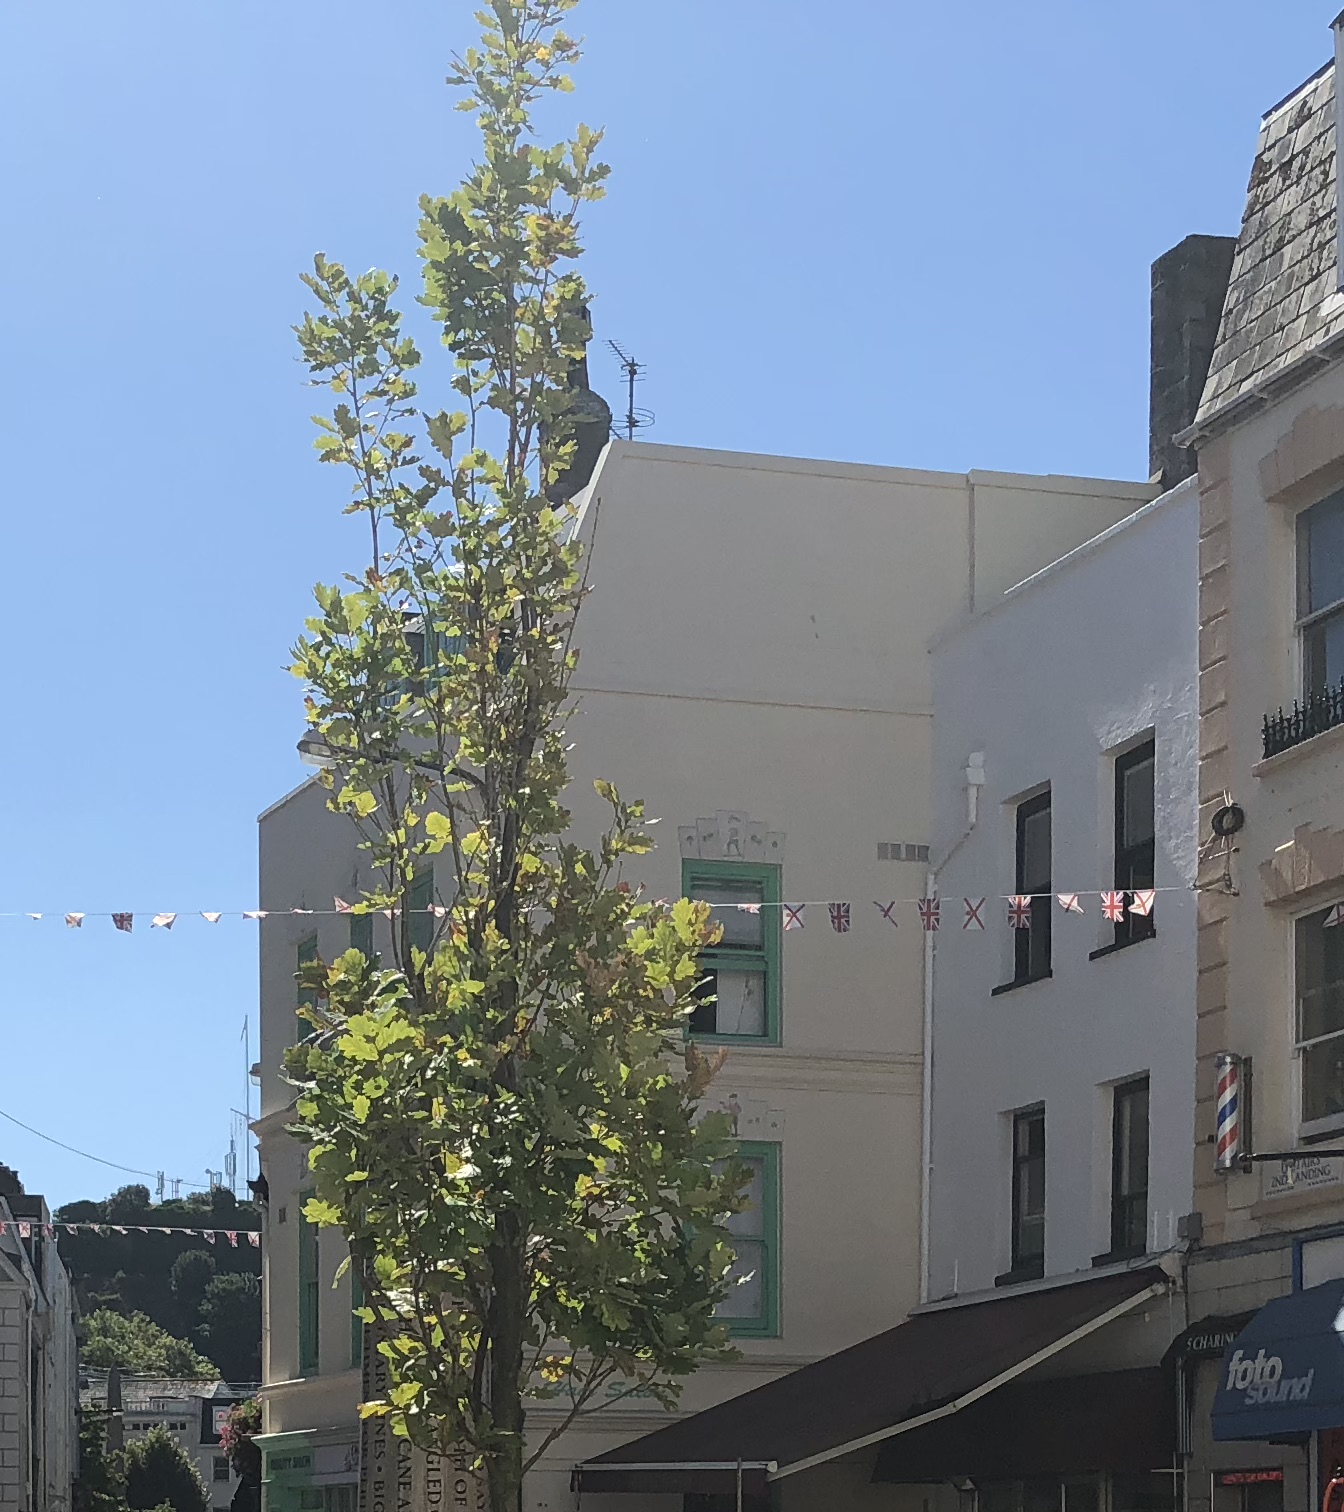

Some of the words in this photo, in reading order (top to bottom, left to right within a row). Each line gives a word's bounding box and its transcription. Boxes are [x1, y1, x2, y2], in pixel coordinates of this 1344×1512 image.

[1290, 1164, 1332, 1182] ANDING
[1193, 1331, 1240, 1350] CHARIN
[1225, 1349, 1283, 1391] foto
[1244, 1367, 1315, 1405] sound
[455, 1478, 468, 1506] OF
